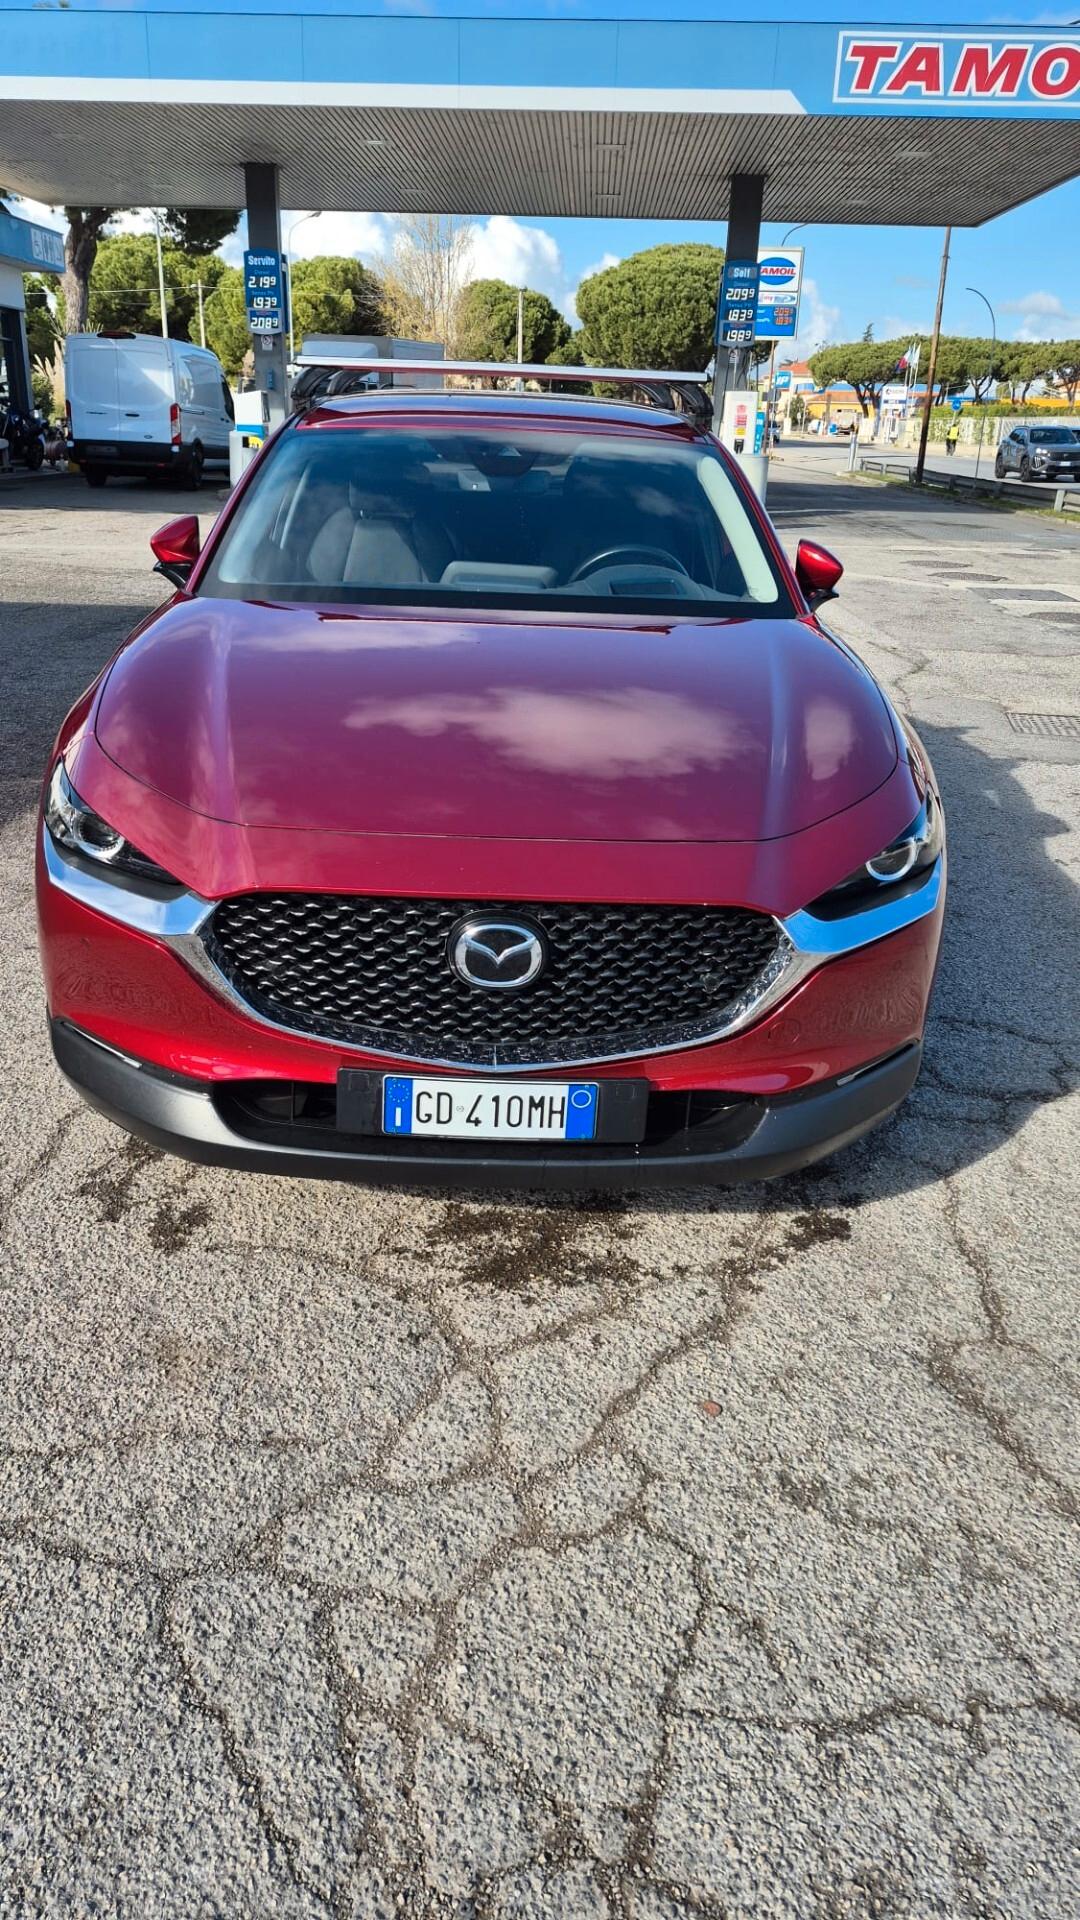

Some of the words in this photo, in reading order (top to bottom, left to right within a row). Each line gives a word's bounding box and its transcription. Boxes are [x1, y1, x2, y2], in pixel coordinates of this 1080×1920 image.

[248, 255, 276, 266] Servito
[733, 268, 751, 278] Self
[760, 267, 797, 275] AMOIL
[415, 1091, 453, 1126] GD
[465, 1093, 566, 1129] 410MH
